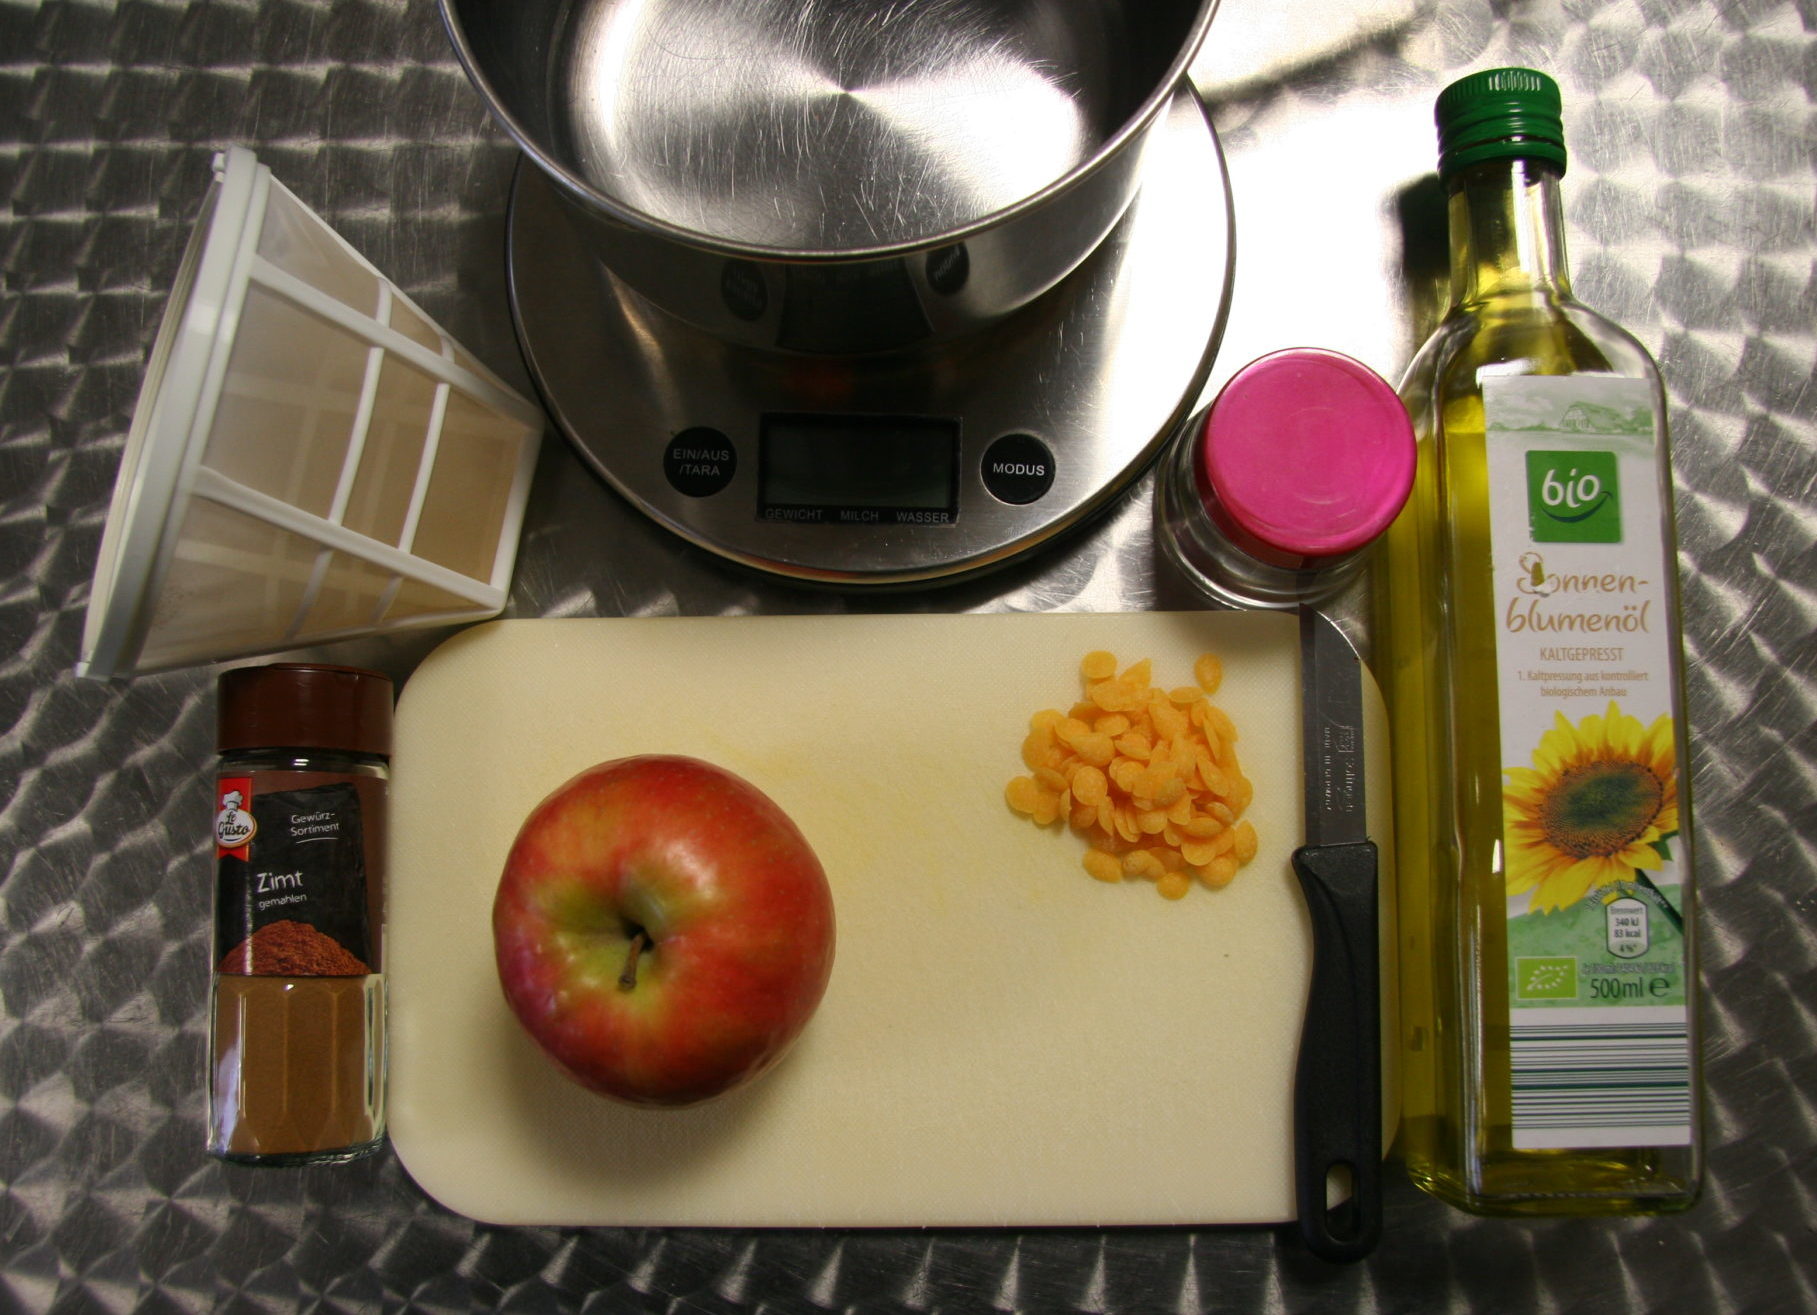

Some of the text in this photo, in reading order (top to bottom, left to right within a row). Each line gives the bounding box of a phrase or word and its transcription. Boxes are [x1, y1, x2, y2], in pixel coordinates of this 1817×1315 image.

[673, 448, 730, 462] EIN/AUS
[679, 464, 721, 477] /TARA
[993, 462, 1046, 476] MODUS
[1541, 468, 1601, 508] bio
[765, 508, 950, 524] GEWICHT MILCH WASSER
[1506, 597, 1651, 633] blumenöl
[1540, 647, 1625, 661] KALTGEPRESST
[291, 811, 336, 824] Gewürz-
[290, 822, 340, 837] Sortiment
[256, 870, 304, 893] Zimt
[258, 893, 308, 911] gemahlen
